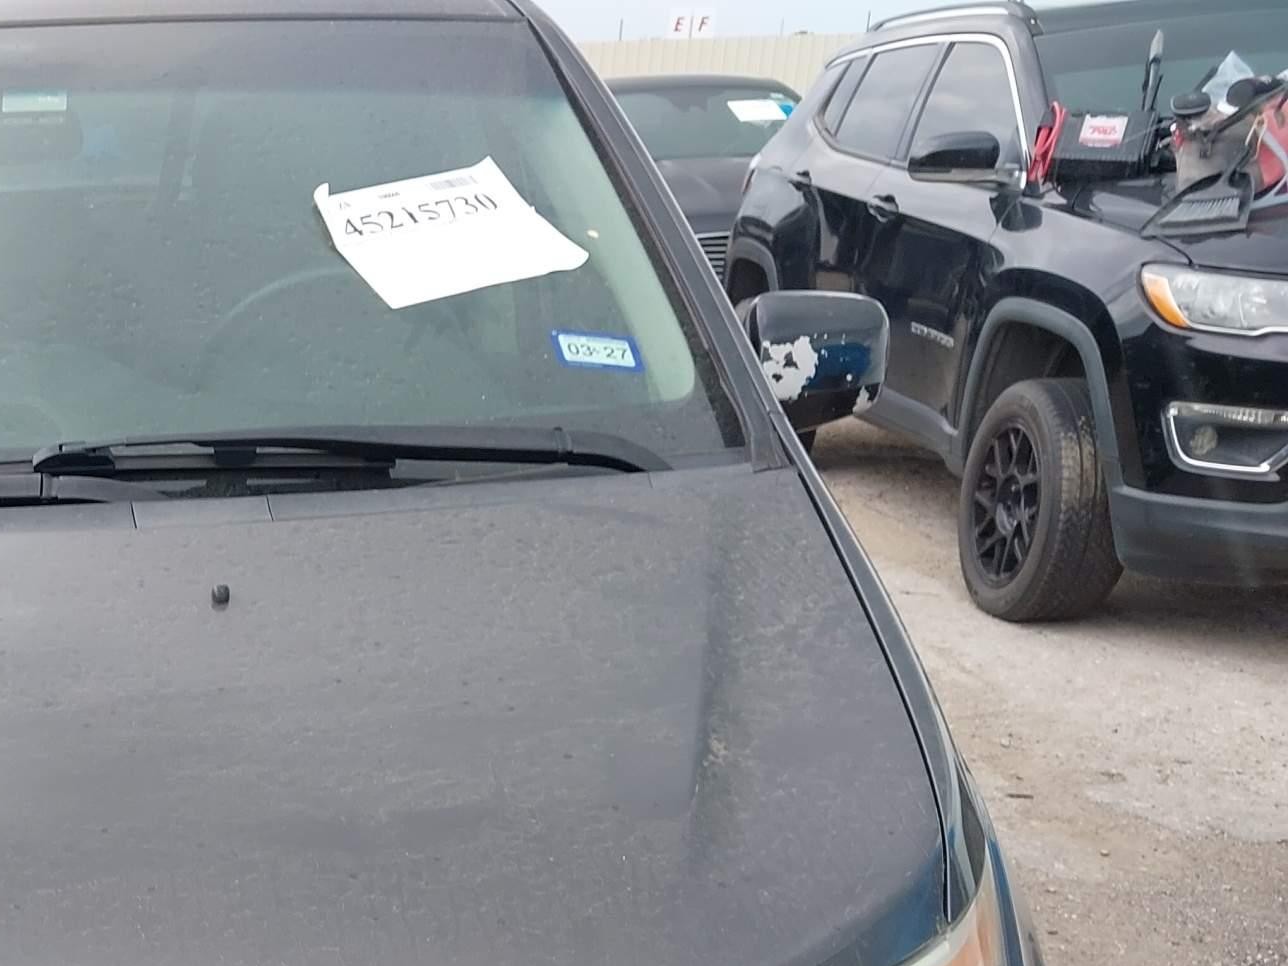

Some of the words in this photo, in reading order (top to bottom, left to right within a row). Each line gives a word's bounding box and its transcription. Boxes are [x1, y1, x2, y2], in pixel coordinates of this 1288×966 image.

[673, 16, 685, 32] E
[698, 16, 710, 32] F
[344, 192, 499, 237] 45215730
